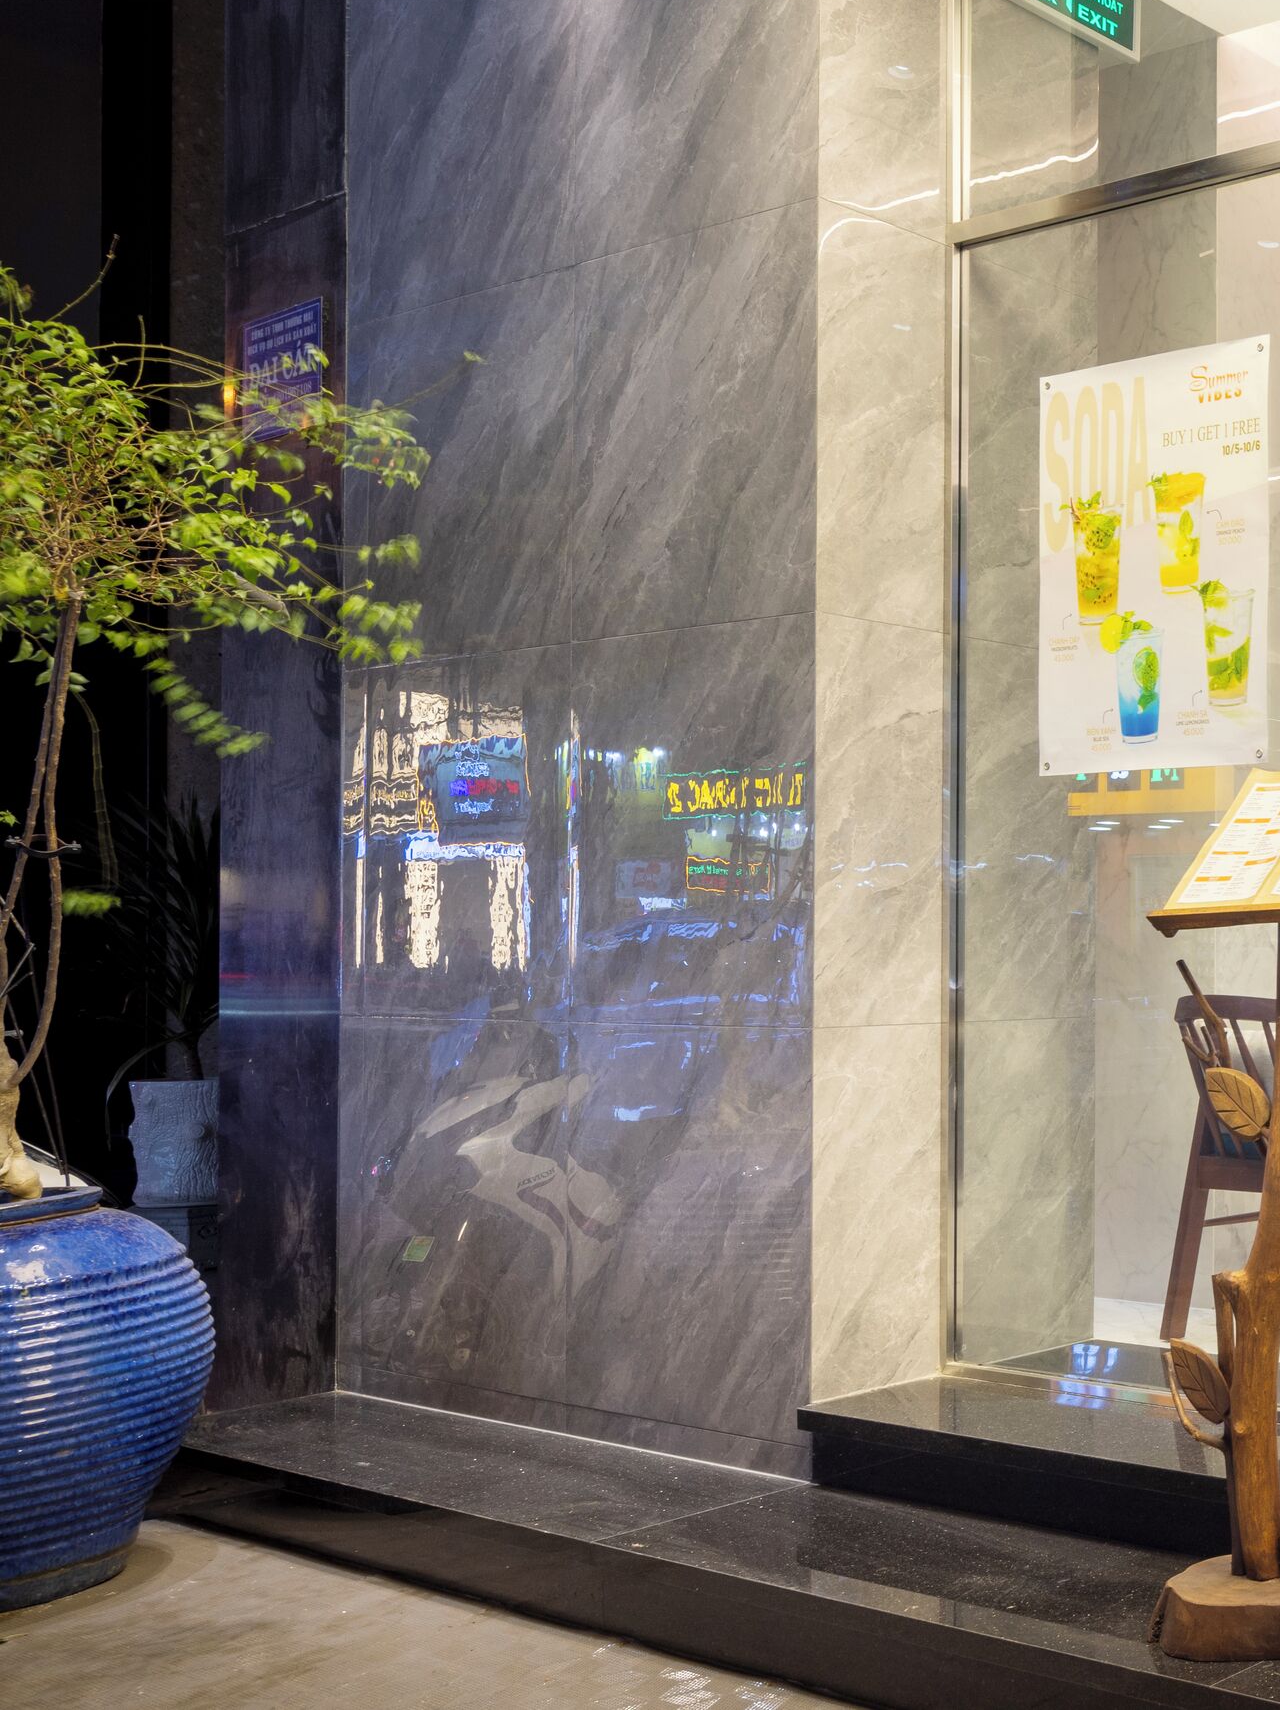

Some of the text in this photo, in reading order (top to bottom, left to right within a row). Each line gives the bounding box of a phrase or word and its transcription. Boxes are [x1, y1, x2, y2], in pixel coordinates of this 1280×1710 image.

[1077, 3, 1118, 36] EXIT
[1189, 364, 1249, 392] Summer
[1162, 429, 1187, 448] BUY
[1197, 424, 1220, 442] GET
[1231, 417, 1261, 436] FREE
[1222, 439, 1261, 457] 10/5-10/6
[1044, 376, 1151, 553] SODA
